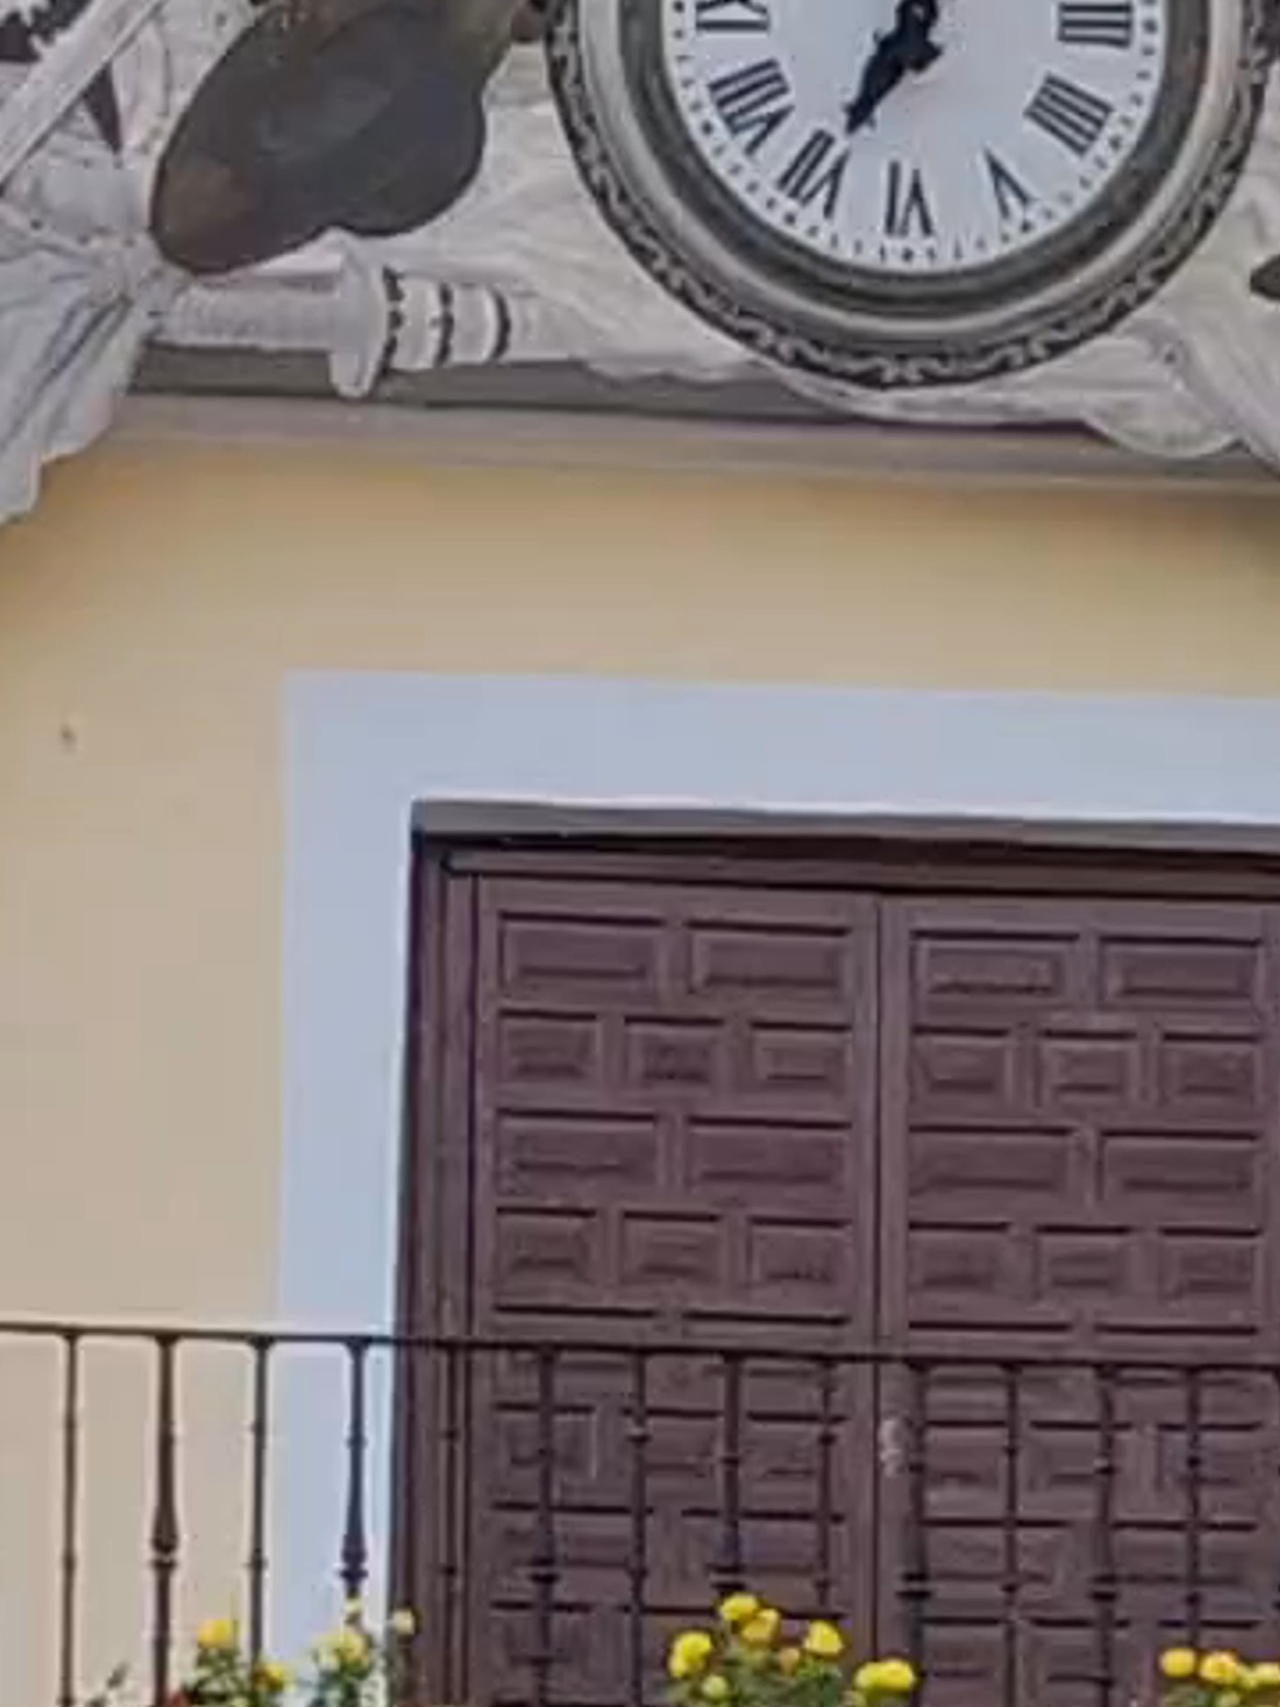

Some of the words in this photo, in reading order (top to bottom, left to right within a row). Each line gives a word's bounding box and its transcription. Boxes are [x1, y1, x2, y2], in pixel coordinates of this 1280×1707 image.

[1057, 1, 1134, 49] III
[706, 59, 796, 156] VIII
[1023, 73, 1115, 157] IIII
[776, 129, 850, 219] VII
[884, 160, 934, 237] VI
[982, 146, 1034, 220] V
